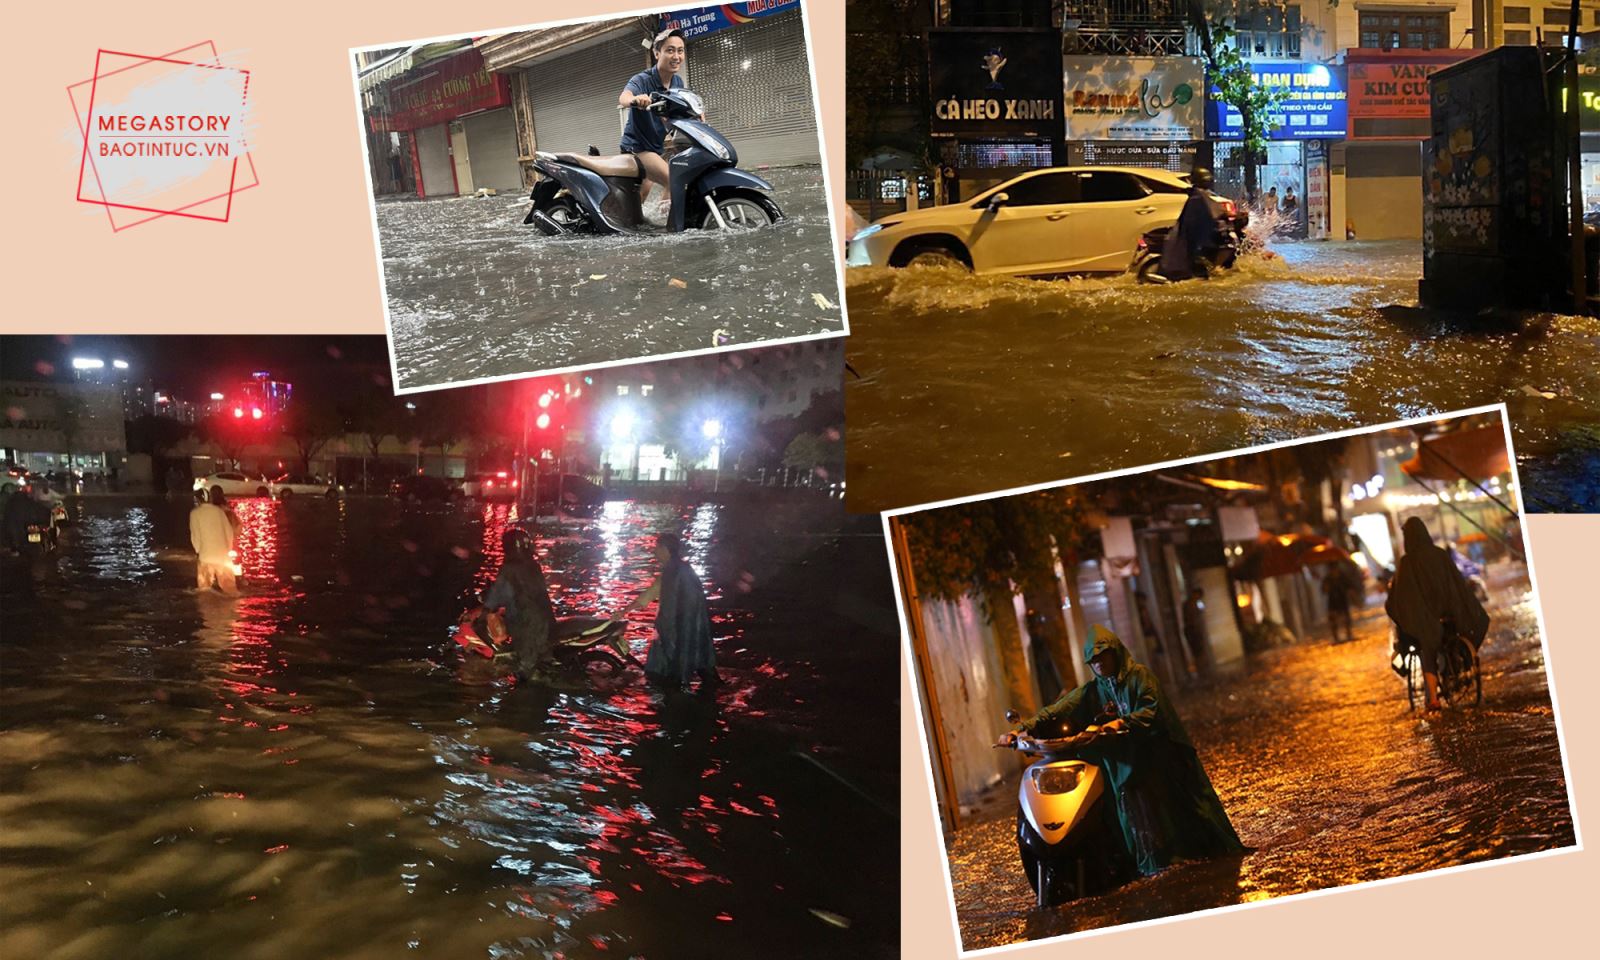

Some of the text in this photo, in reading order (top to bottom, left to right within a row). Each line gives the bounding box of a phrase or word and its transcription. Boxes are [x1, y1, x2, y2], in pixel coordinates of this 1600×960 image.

[680, 18, 692, 29] Hà
[692, 12, 717, 25] Trung
[1364, 81, 1398, 96] KIM
[936, 94, 1055, 120] CÁ HEO XANH
